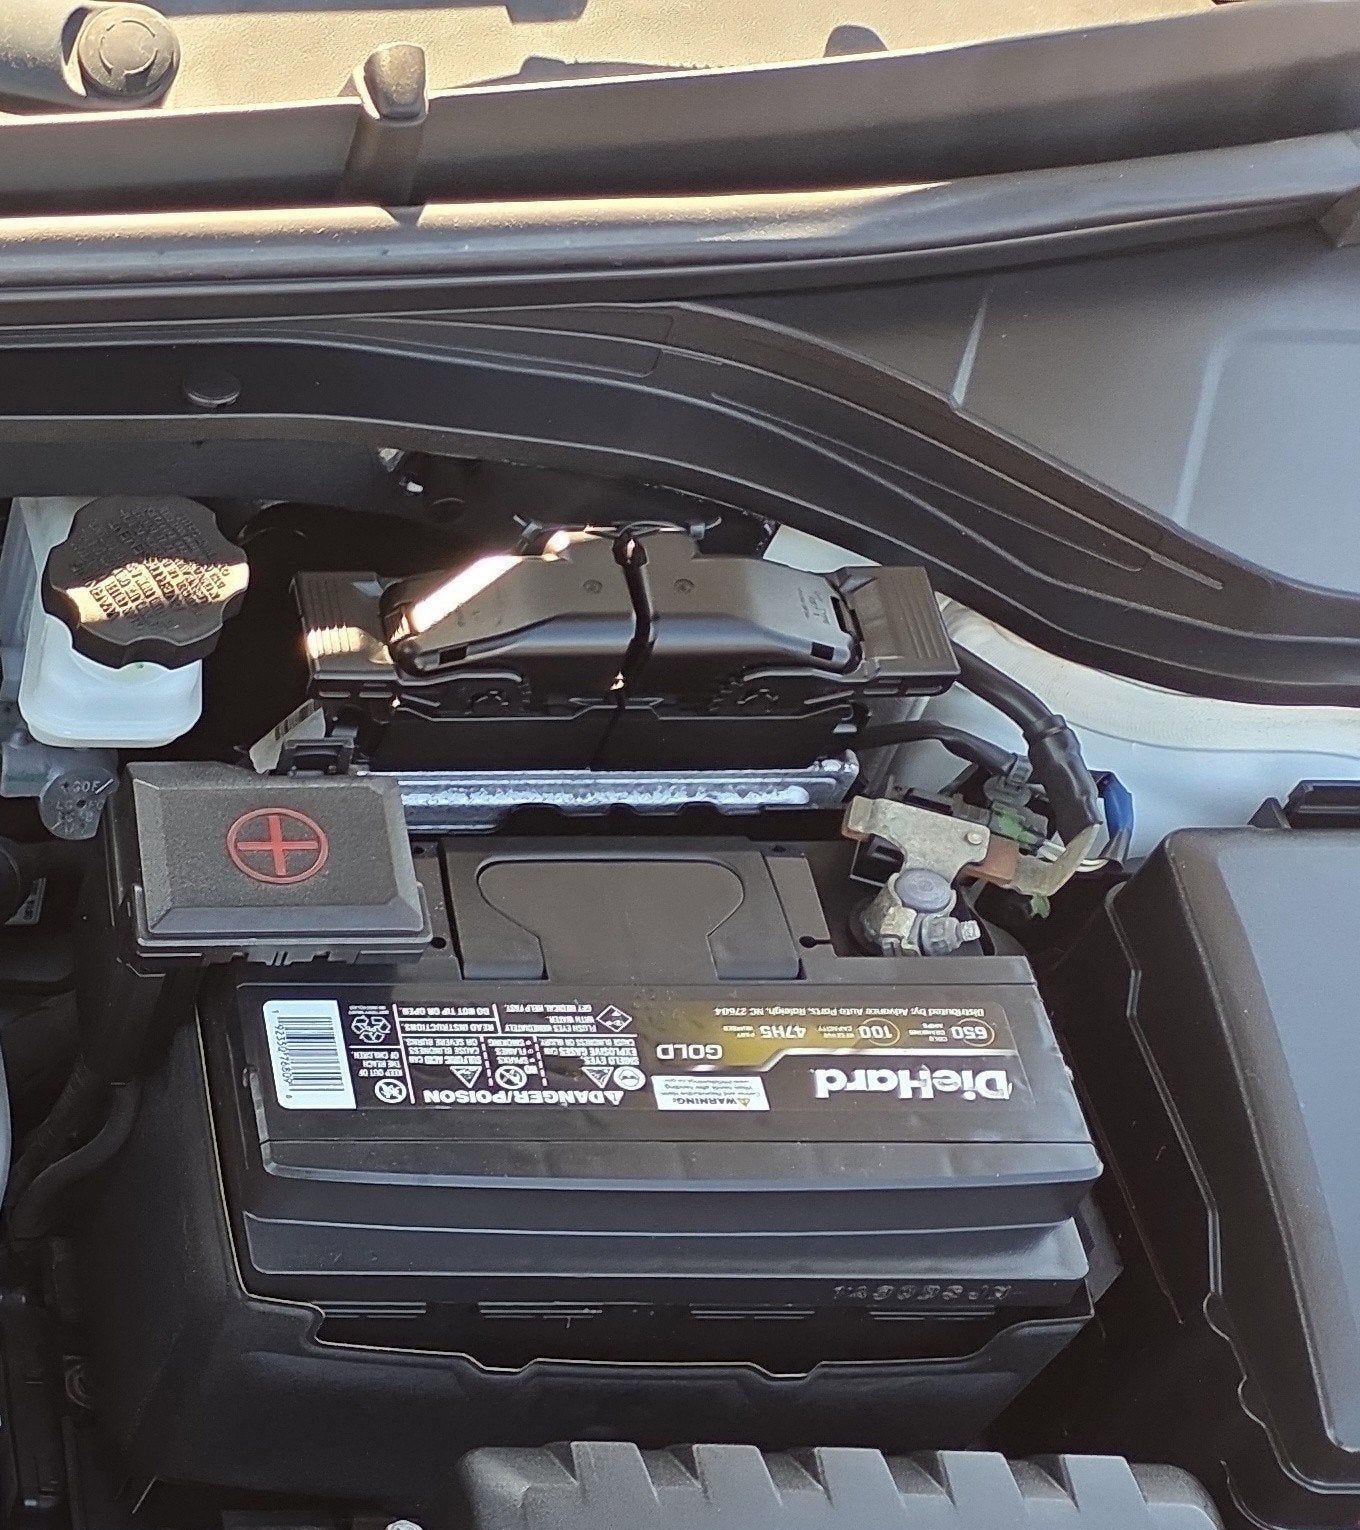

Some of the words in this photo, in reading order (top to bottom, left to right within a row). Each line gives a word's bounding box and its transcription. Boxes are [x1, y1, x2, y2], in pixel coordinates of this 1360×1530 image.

[749, 1007, 764, 1015] NC
[808, 1006, 837, 1016] Parts,
[839, 1007, 863, 1016] Auto
[866, 1007, 908, 1016] Advance
[928, 1008, 984, 1017] Distributed
[470, 1023, 494, 1031] READ
[759, 1025, 806, 1038] 47H5
[858, 1025, 893, 1039] 100
[950, 1025, 988, 1039] 650
[656, 1043, 723, 1060] GOLD
[814, 1068, 1011, 1101] DieHard
[423, 1090, 605, 1104] DANGER/POISON
